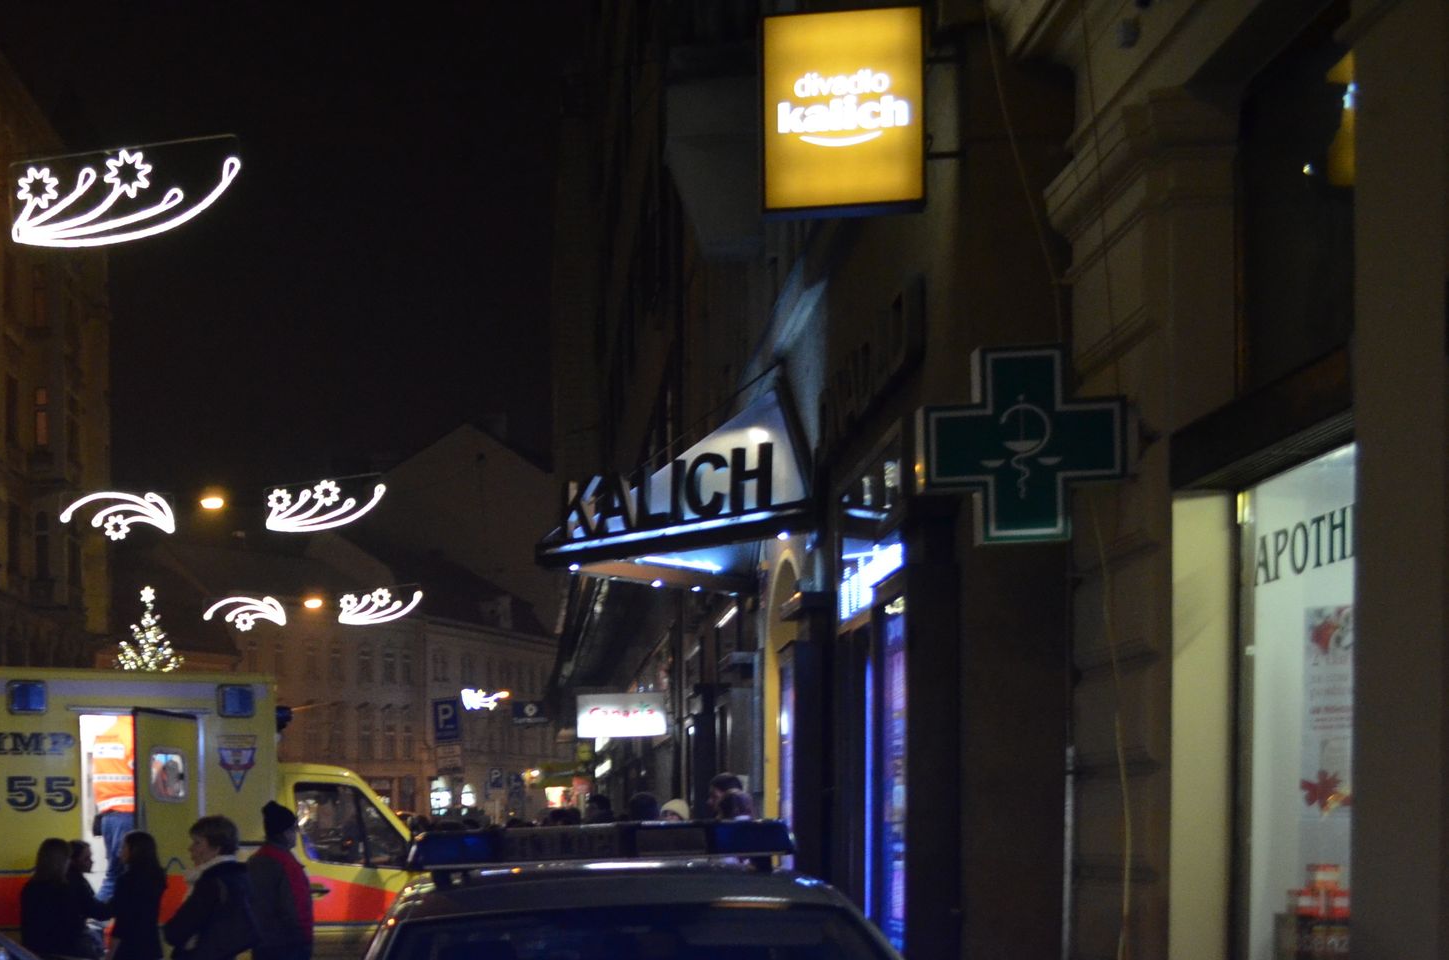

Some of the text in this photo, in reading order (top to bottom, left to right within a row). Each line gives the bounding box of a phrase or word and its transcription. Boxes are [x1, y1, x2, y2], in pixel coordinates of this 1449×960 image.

[777, 94, 910, 134] kalich
[793, 68, 890, 98] divadlo
[561, 442, 774, 542] KALICH
[1253, 503, 1357, 587] APOTH
